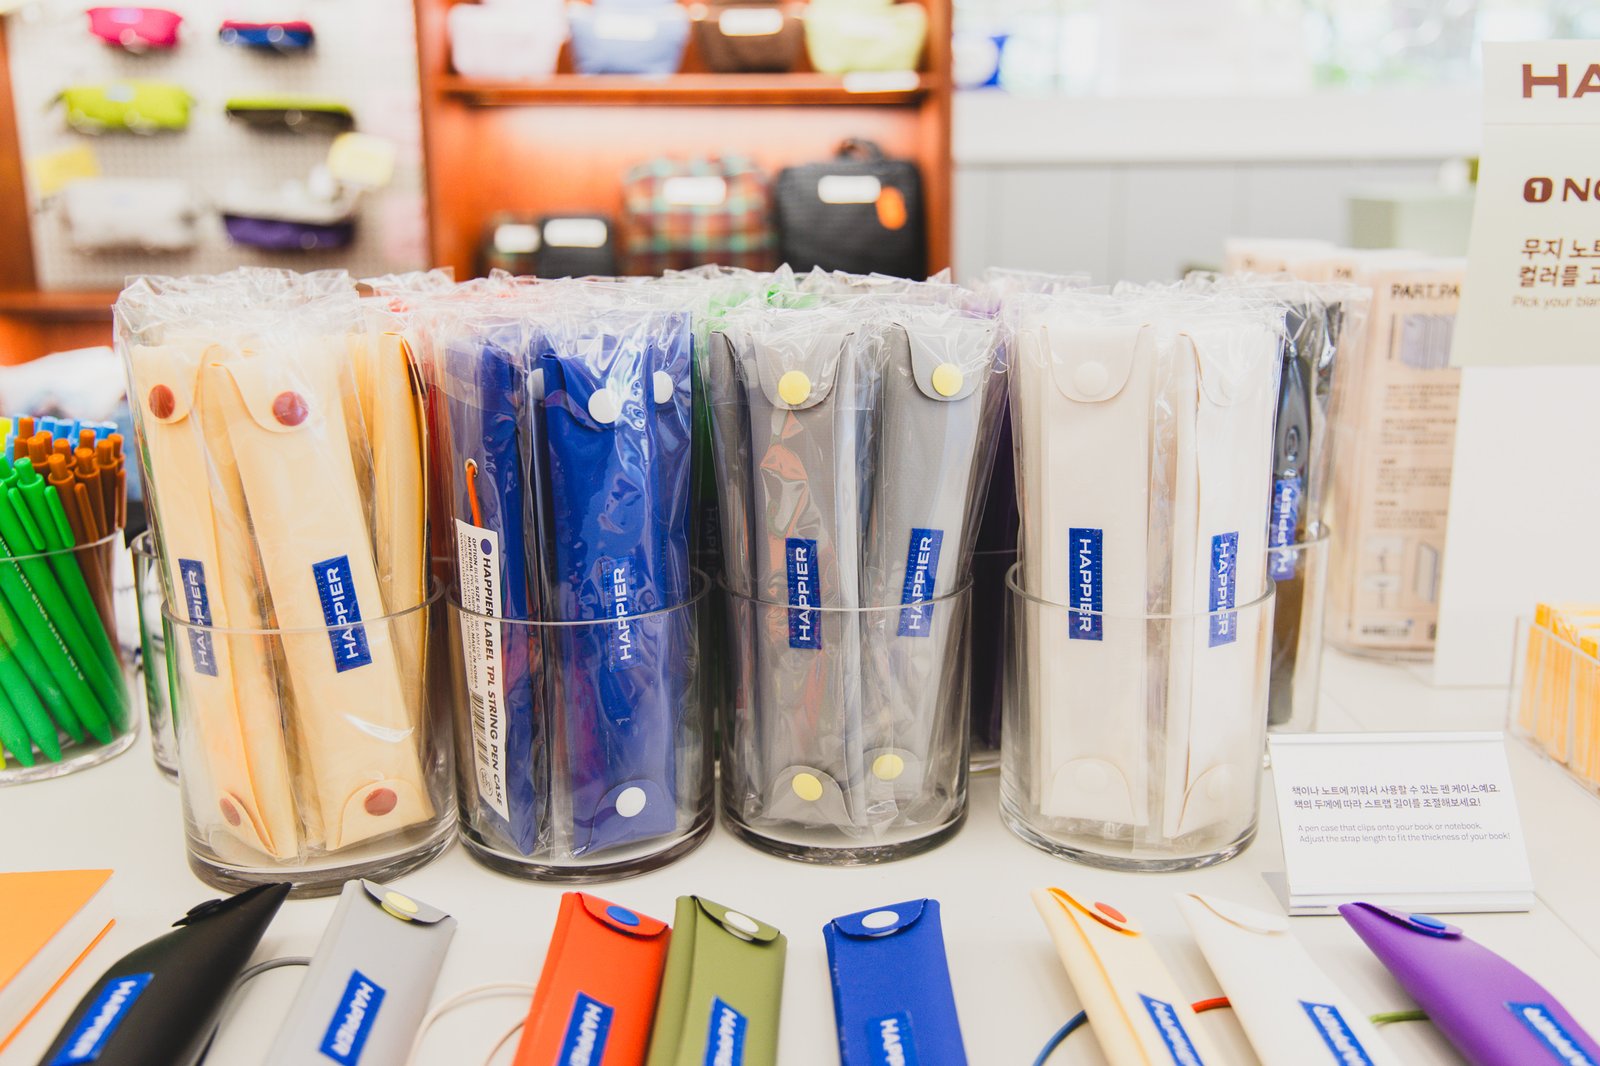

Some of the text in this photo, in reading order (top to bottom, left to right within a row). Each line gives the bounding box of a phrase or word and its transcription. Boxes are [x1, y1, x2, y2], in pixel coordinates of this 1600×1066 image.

[1562, 177, 1600, 202] N
[1520, 265, 1579, 288] 컬러를
[1521, 238, 1563, 260] 무지
[188, 570, 209, 667] HAPPIER
[327, 566, 359, 660] HAPPIER
[614, 567, 632, 661] HAPPIER
[795, 547, 811, 641] HAPPIER
[908, 536, 933, 630] HAPPIER
[1079, 538, 1092, 632] HAPPIER
[1217, 542, 1230, 636] HAPPIER
[483, 557, 503, 806] HAPPIER LABEL TPL STRING PEN CASE
[1292, 783, 1500, 796] 책이나 노트에 끼워서 사용할 수 있는 펜 케이스예요.
[1294, 797, 1481, 809] 책의 두께에 따라 스트랩 길이를 조절해보세요!
[1357, 824, 1376, 832] clips
[1396, 824, 1413, 832] your
[1300, 835, 1324, 844] Adjust
[1340, 835, 1360, 843] strap
[1362, 834, 1386, 844] length
[1421, 833, 1460, 841] thickness
[1470, 833, 1487, 842] your
[1488, 832, 1511, 840] book!
[330, 981, 374, 1057] HAPPIER
